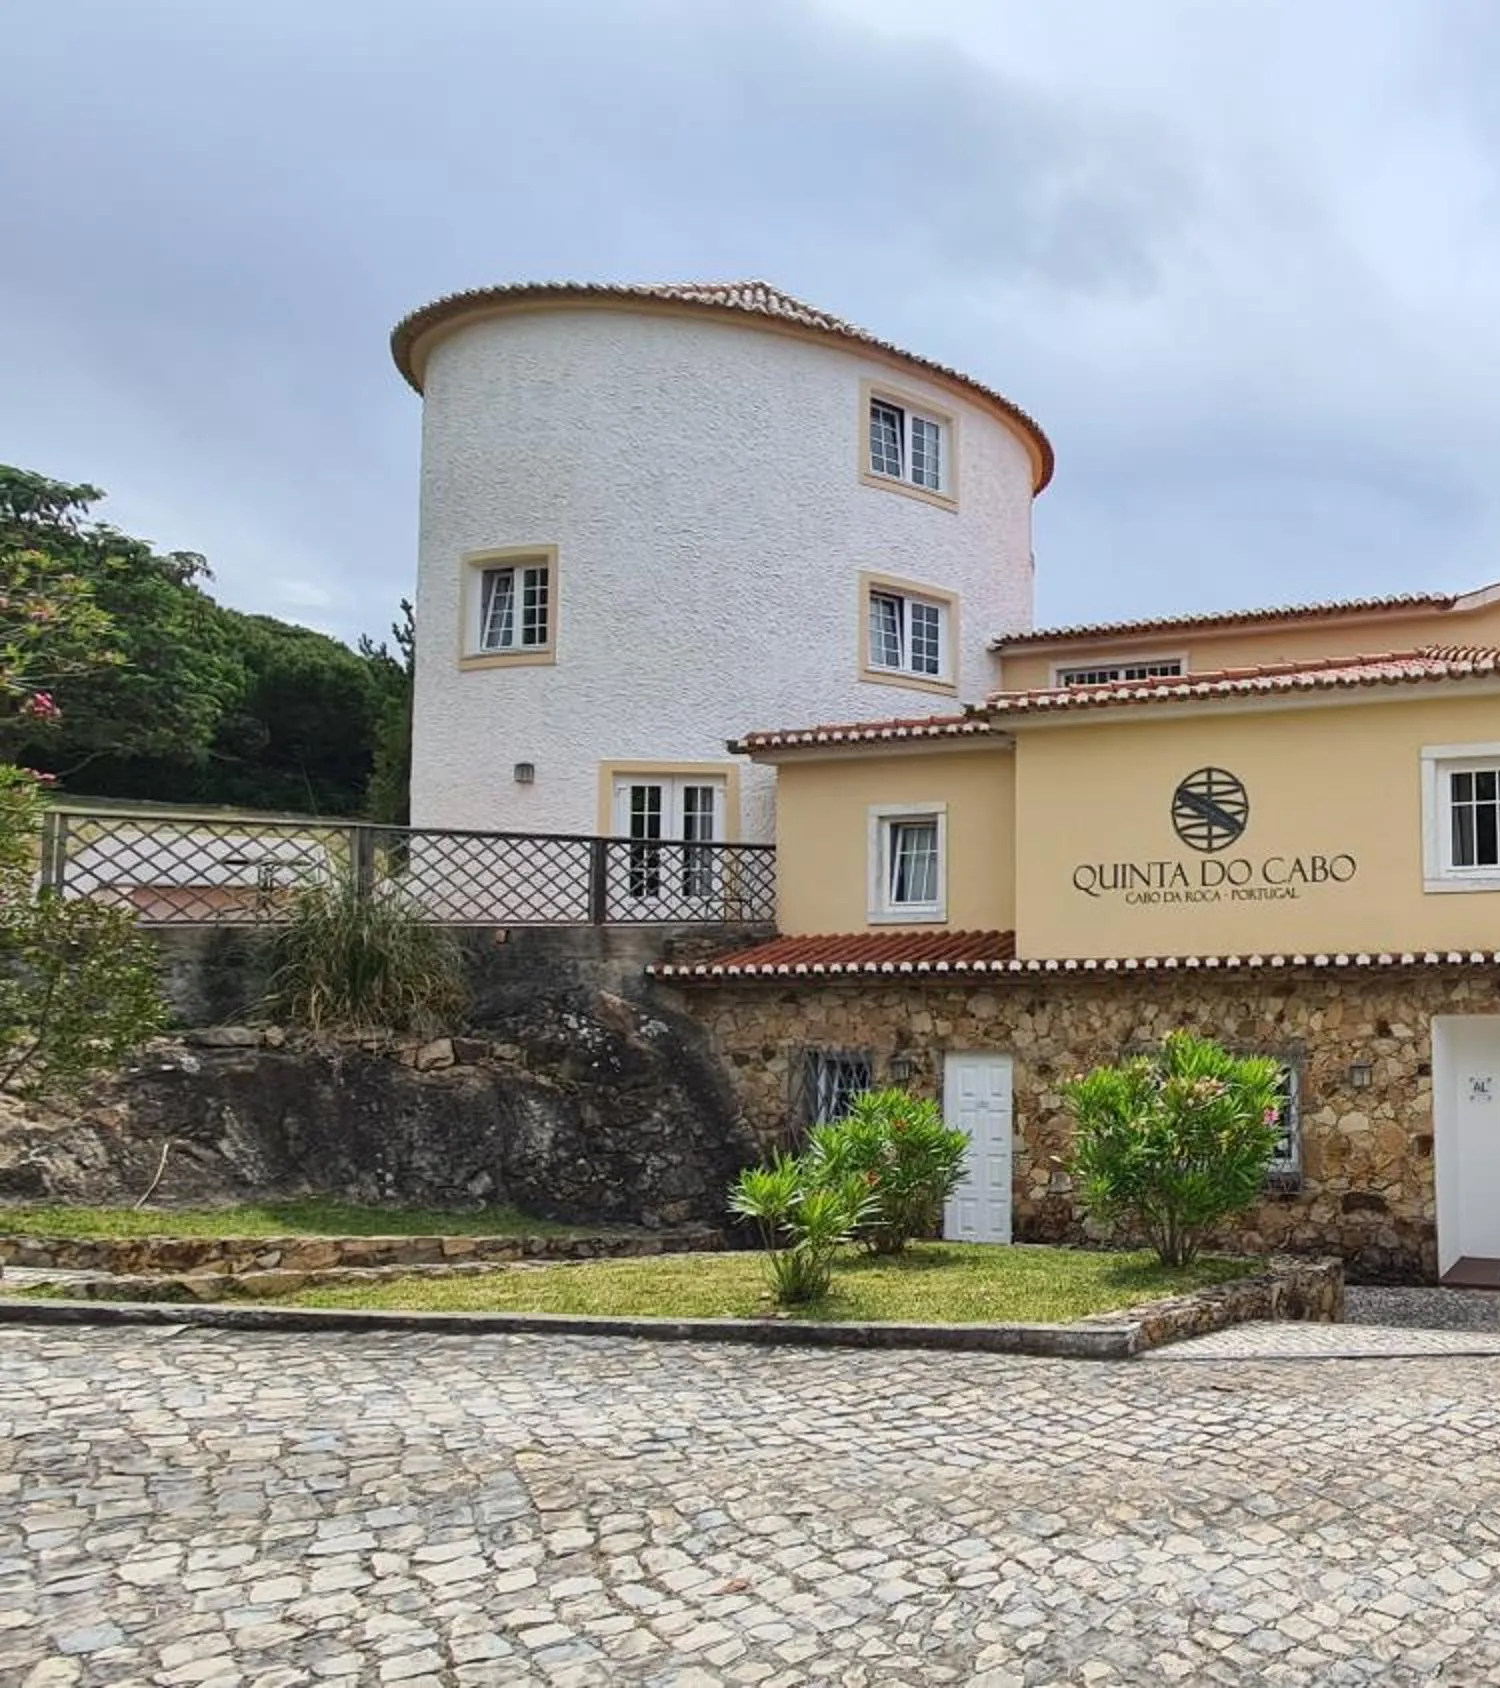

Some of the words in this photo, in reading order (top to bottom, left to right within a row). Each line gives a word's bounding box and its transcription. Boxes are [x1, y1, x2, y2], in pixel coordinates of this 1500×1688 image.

[1073, 861, 1189, 897] QUINTA
[1200, 858, 1252, 887] DO
[1262, 853, 1357, 885] CABO
[1125, 891, 1161, 905] CABO
[1163, 891, 1182, 904] DA
[1185, 890, 1222, 904] ROCA
[1231, 887, 1299, 902] PORTUGAL
[1473, 1081, 1489, 1093] AL
